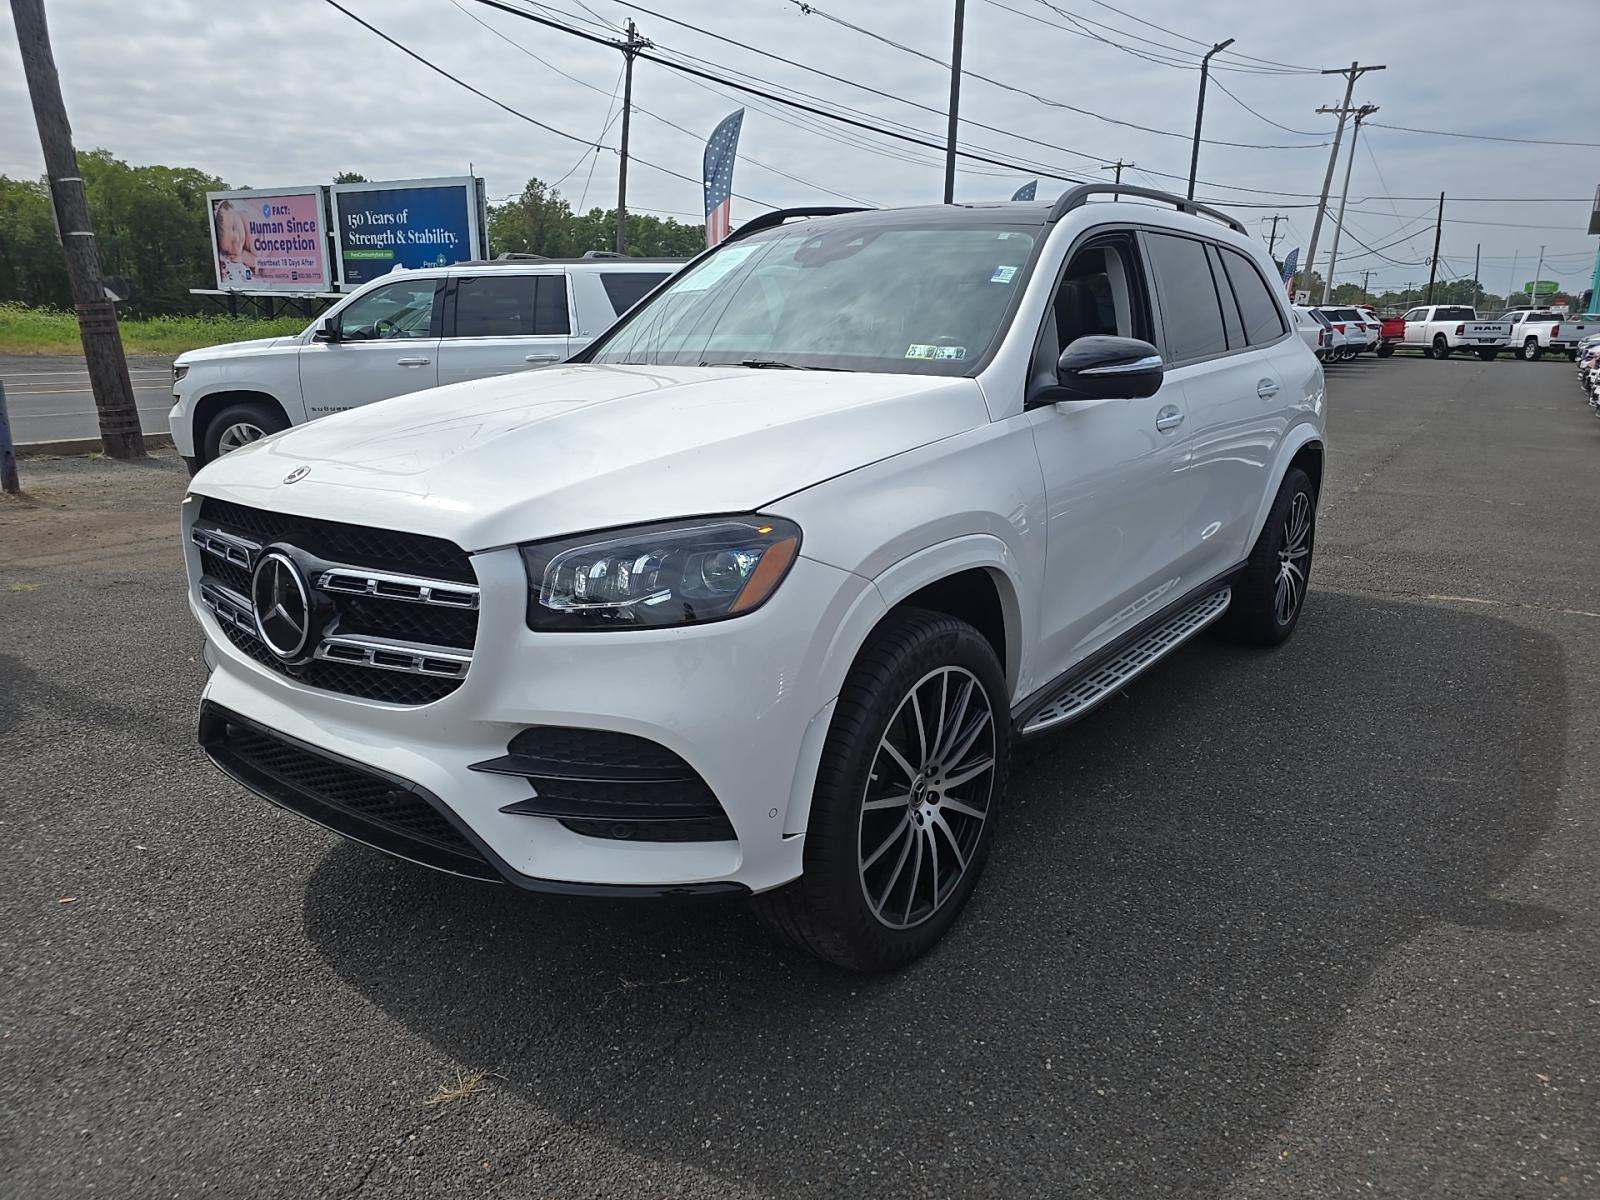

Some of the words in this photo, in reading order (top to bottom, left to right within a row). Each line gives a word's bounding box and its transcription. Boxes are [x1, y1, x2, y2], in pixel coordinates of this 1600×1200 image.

[272, 205, 290, 216] FACT:
[347, 213, 364, 229] 150
[365, 210, 395, 225] Years
[396, 208, 409, 224] of
[249, 220, 284, 234] Human
[287, 217, 316, 233] Since
[254, 235, 315, 253] Conception
[349, 229, 395, 249] Strength
[396, 230, 407, 244] &
[408, 227, 459, 249] Stability.
[257, 259, 280, 267] Heartbeat
[289, 258, 301, 268] Days
[302, 258, 315, 266] After
